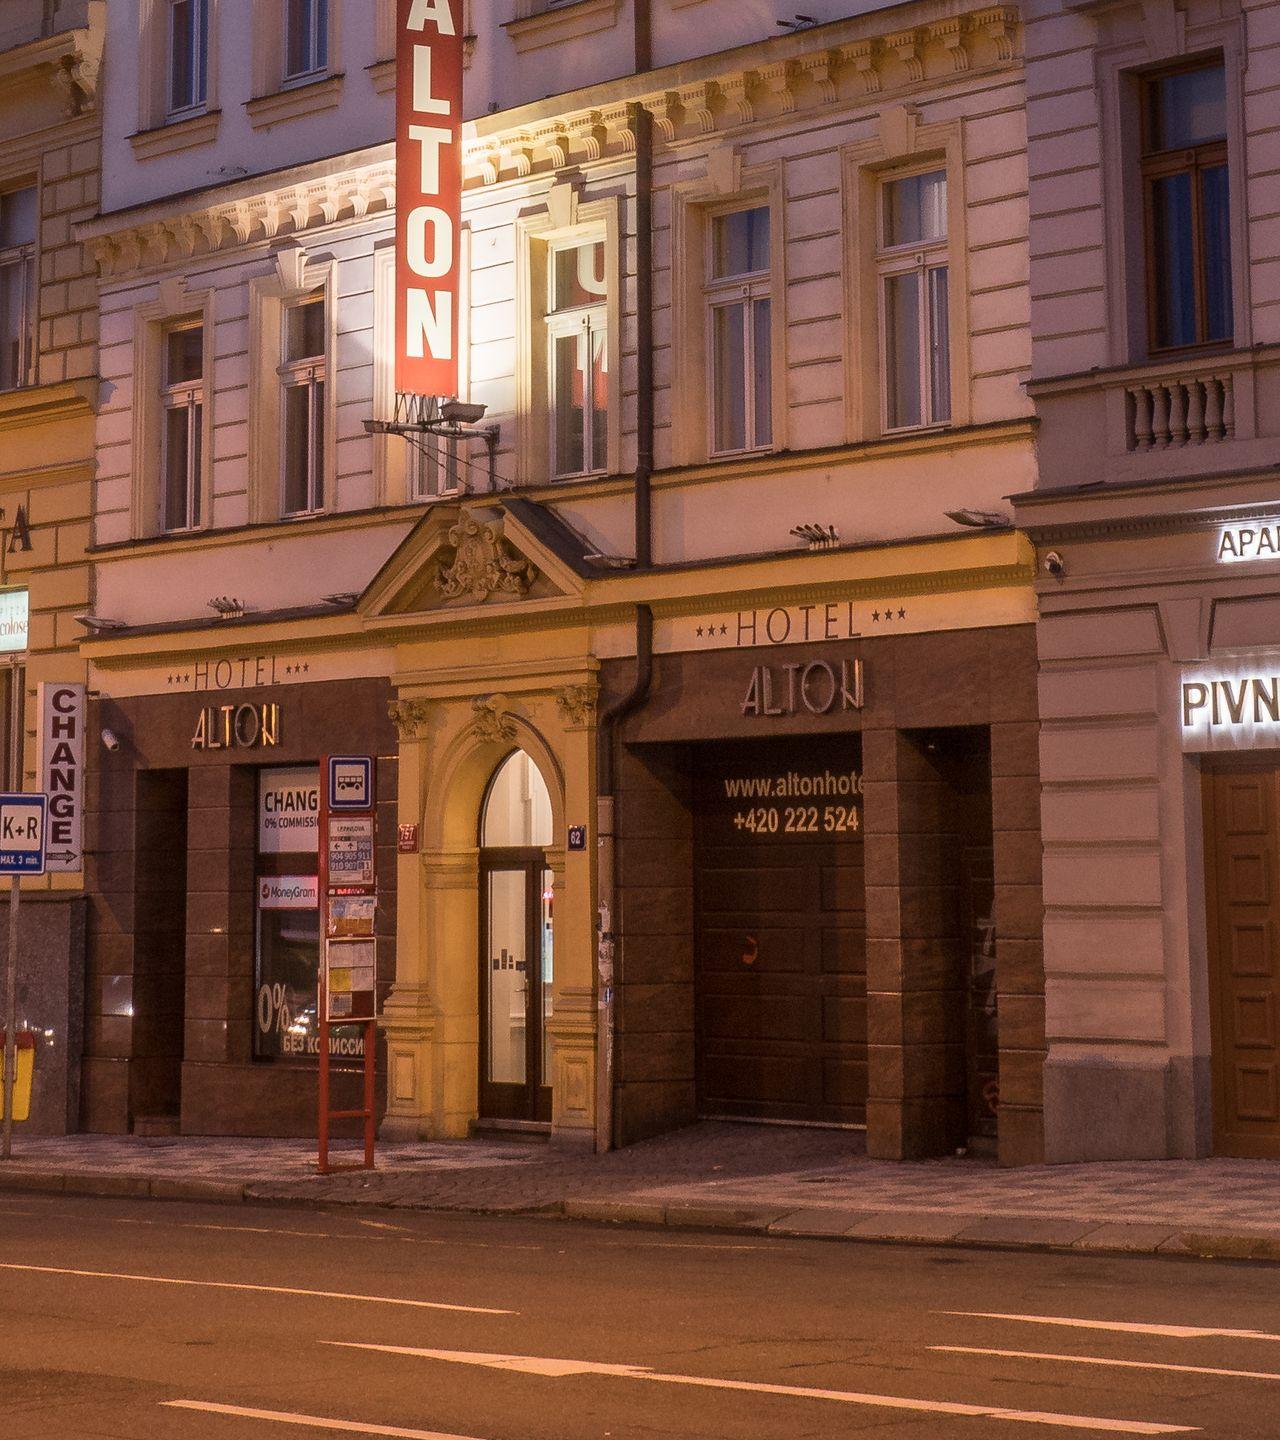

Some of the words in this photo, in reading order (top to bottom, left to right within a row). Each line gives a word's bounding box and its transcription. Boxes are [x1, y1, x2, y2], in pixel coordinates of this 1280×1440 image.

[736, 601, 862, 646] HOTEL
[194, 655, 281, 690] HOTEL
[739, 659, 865, 715] ALTON
[191, 702, 280, 749] ALTON
[49, 688, 77, 845] CHANGE
[264, 790, 319, 813] CHANG
[3, 816, 39, 840] K+R
[734, 808, 779, 834] +420
[784, 807, 819, 833] 222
[824, 805, 859, 833] 524
[570, 831, 581, 845] 62
[271, 885, 317, 901] MoneyGram
[258, 982, 291, 1034] 0%
[283, 1035, 305, 1052] БЕЗ
